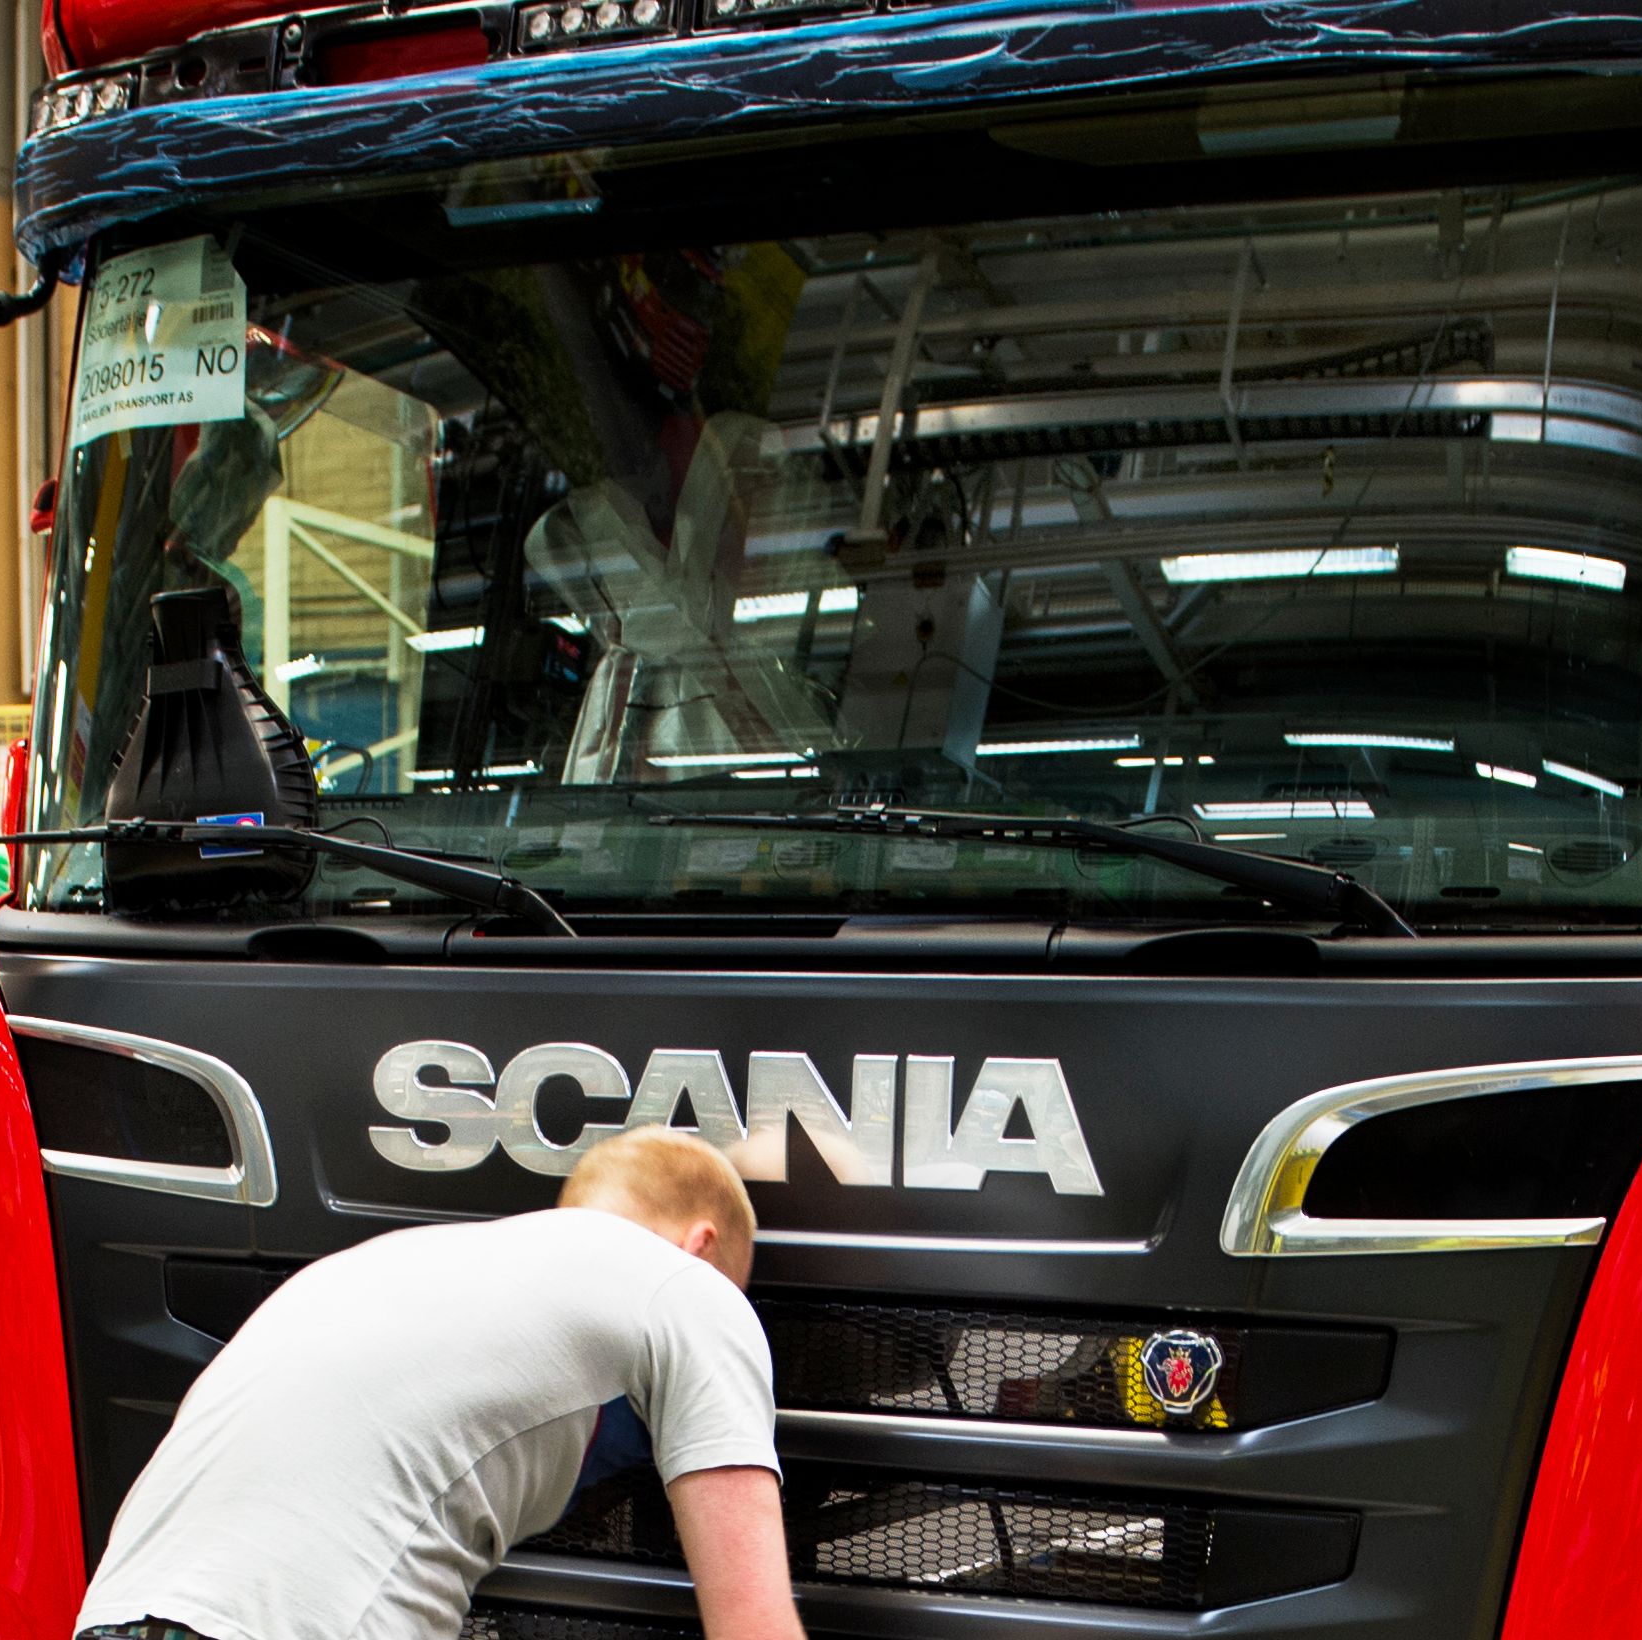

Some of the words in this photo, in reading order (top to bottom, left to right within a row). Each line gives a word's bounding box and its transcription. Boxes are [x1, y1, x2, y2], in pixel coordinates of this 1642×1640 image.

[81, 353, 165, 402] 2098015
[195, 344, 239, 377] NO
[114, 392, 176, 412] TRANSPORT
[178, 391, 194, 404] AS
[368, 1041, 1106, 1197] SCANIA
